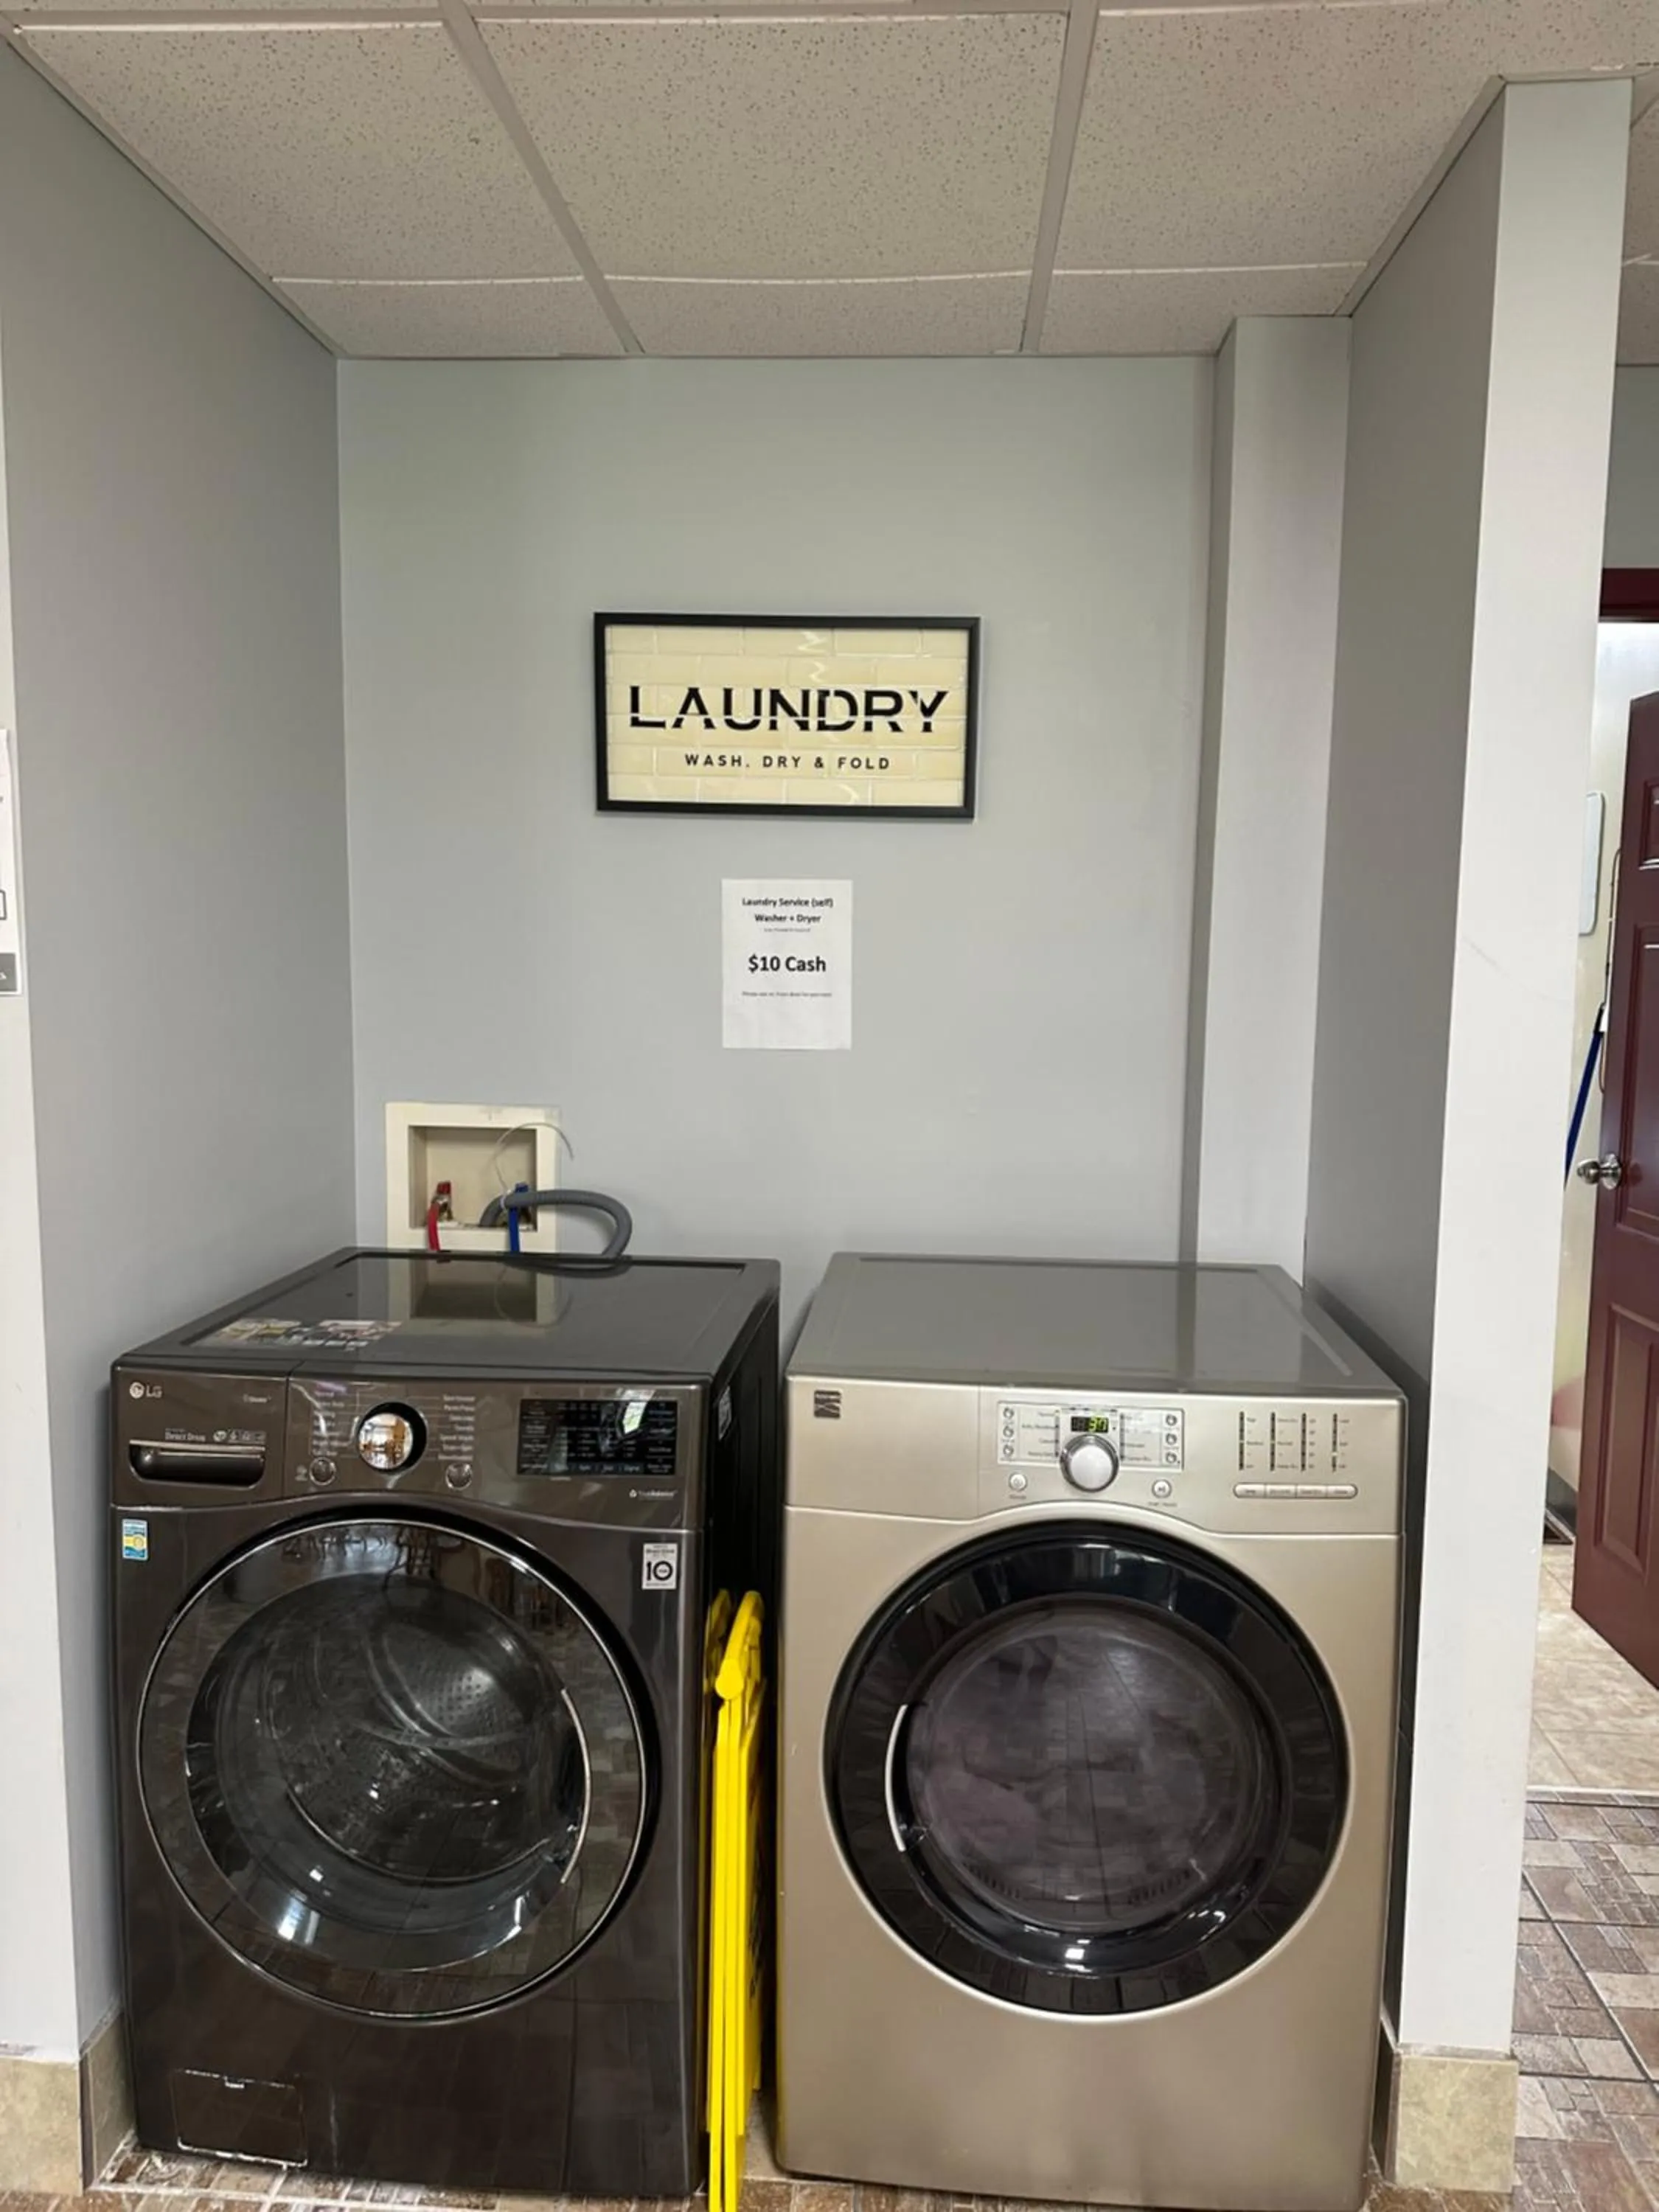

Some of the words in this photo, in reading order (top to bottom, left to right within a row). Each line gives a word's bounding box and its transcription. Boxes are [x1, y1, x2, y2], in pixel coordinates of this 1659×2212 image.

[629, 685, 949, 733] LAUNDRY
[762, 756, 801, 768] DRY
[814, 757, 825, 769] &
[838, 757, 890, 770] FOLD
[742, 897, 777, 908] Laundry
[779, 898, 810, 907] Service
[811, 898, 833, 908] (self)
[796, 914, 821, 923] Dryer
[748, 954, 781, 973] $10
[785, 956, 827, 972] Cash
[146, 1386, 163, 1399] LG
[647, 1560, 673, 1582] 10
